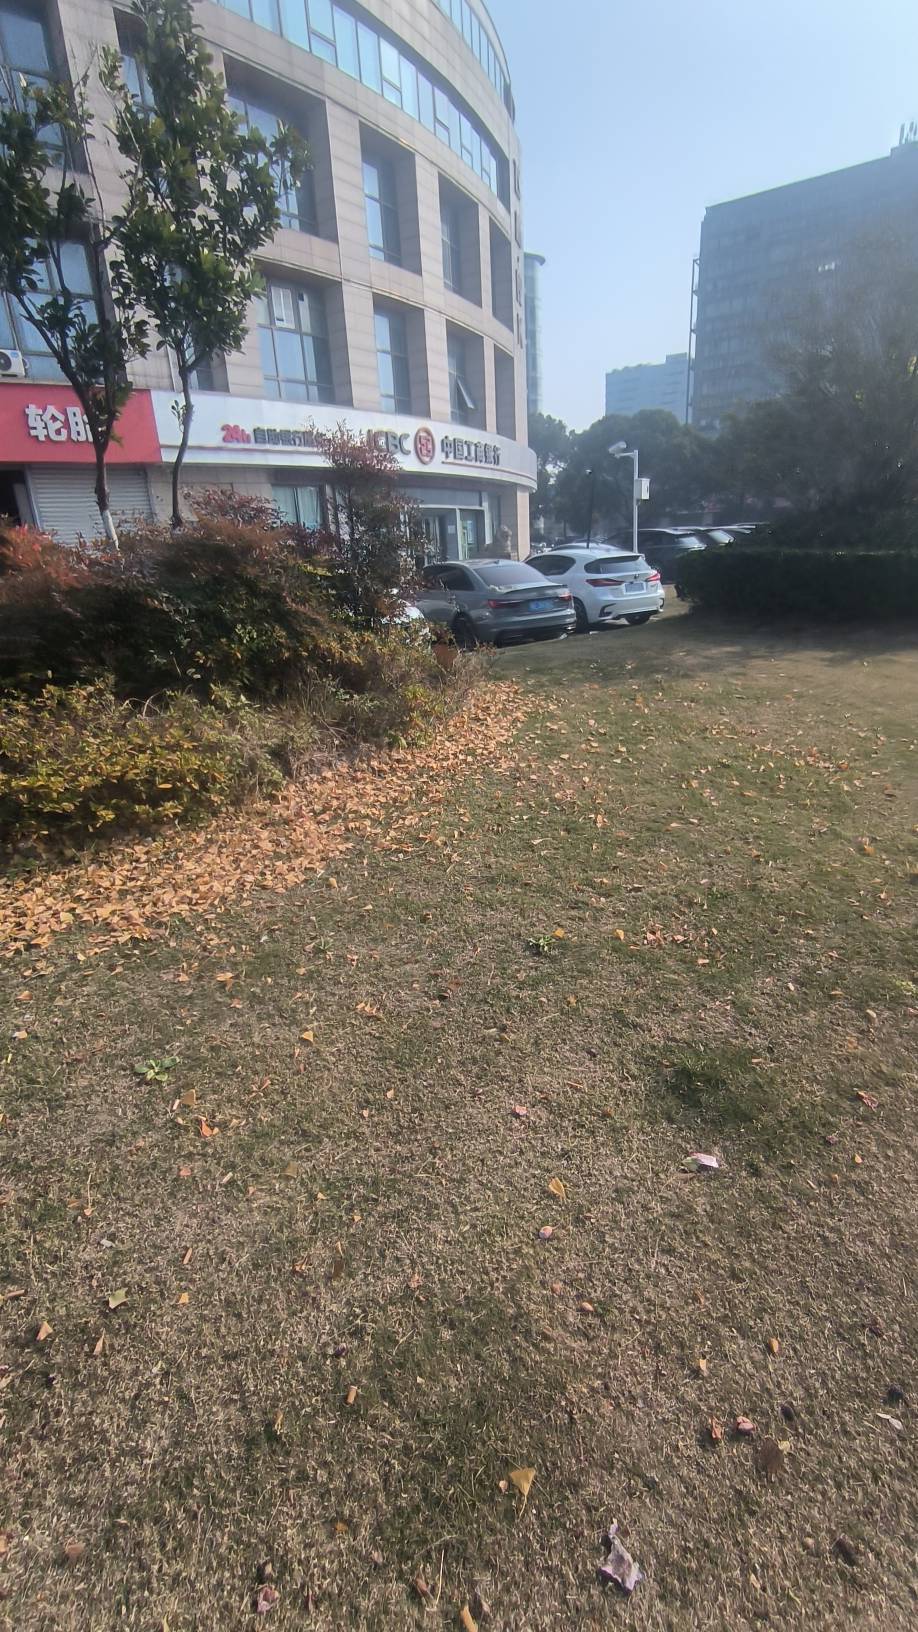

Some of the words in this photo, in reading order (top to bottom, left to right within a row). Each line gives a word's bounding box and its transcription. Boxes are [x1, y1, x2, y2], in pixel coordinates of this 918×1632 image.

[367, 429, 412, 456] ICBC
[441, 435, 502, 466] 中国工商银行
